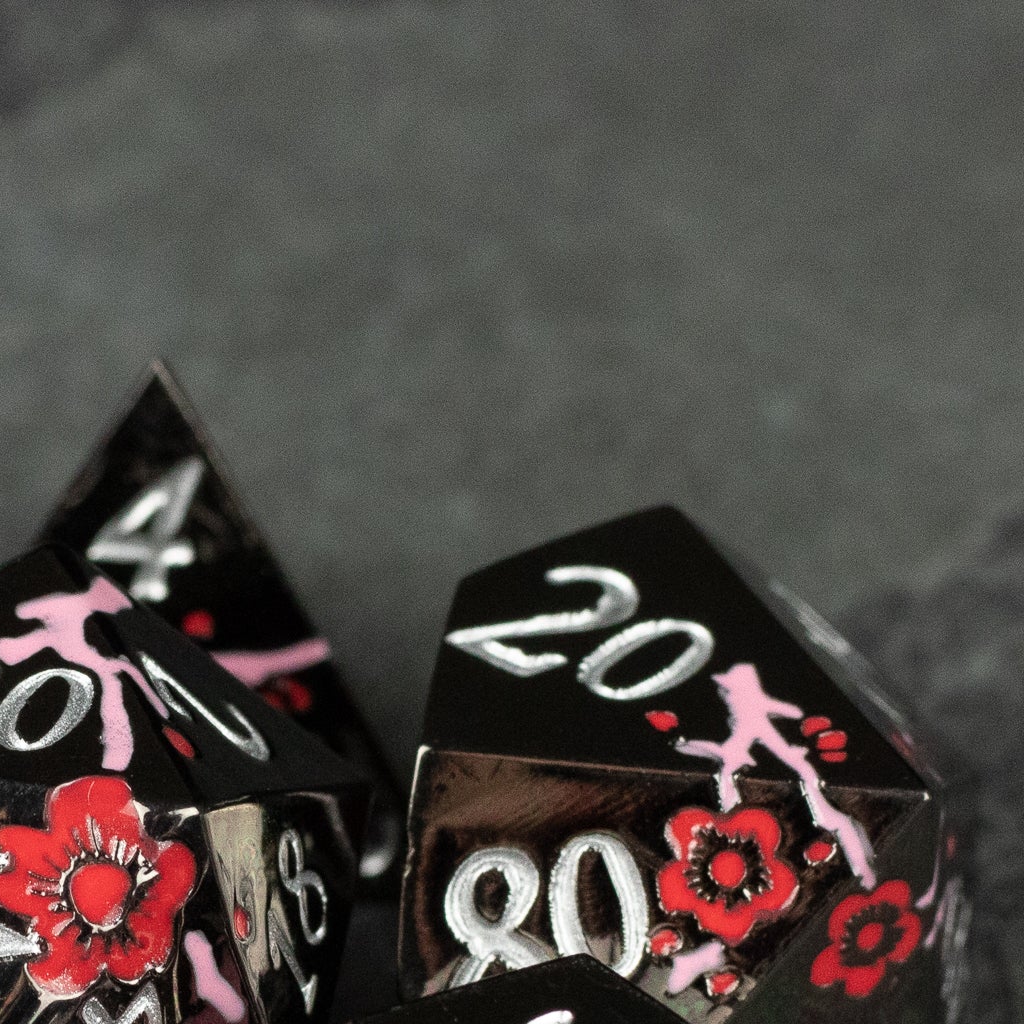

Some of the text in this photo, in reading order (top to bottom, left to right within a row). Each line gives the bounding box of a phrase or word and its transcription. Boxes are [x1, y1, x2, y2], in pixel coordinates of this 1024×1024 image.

[85, 455, 206, 602] 4
[446, 565, 715, 701] 20
[444, 830, 650, 989] 80
